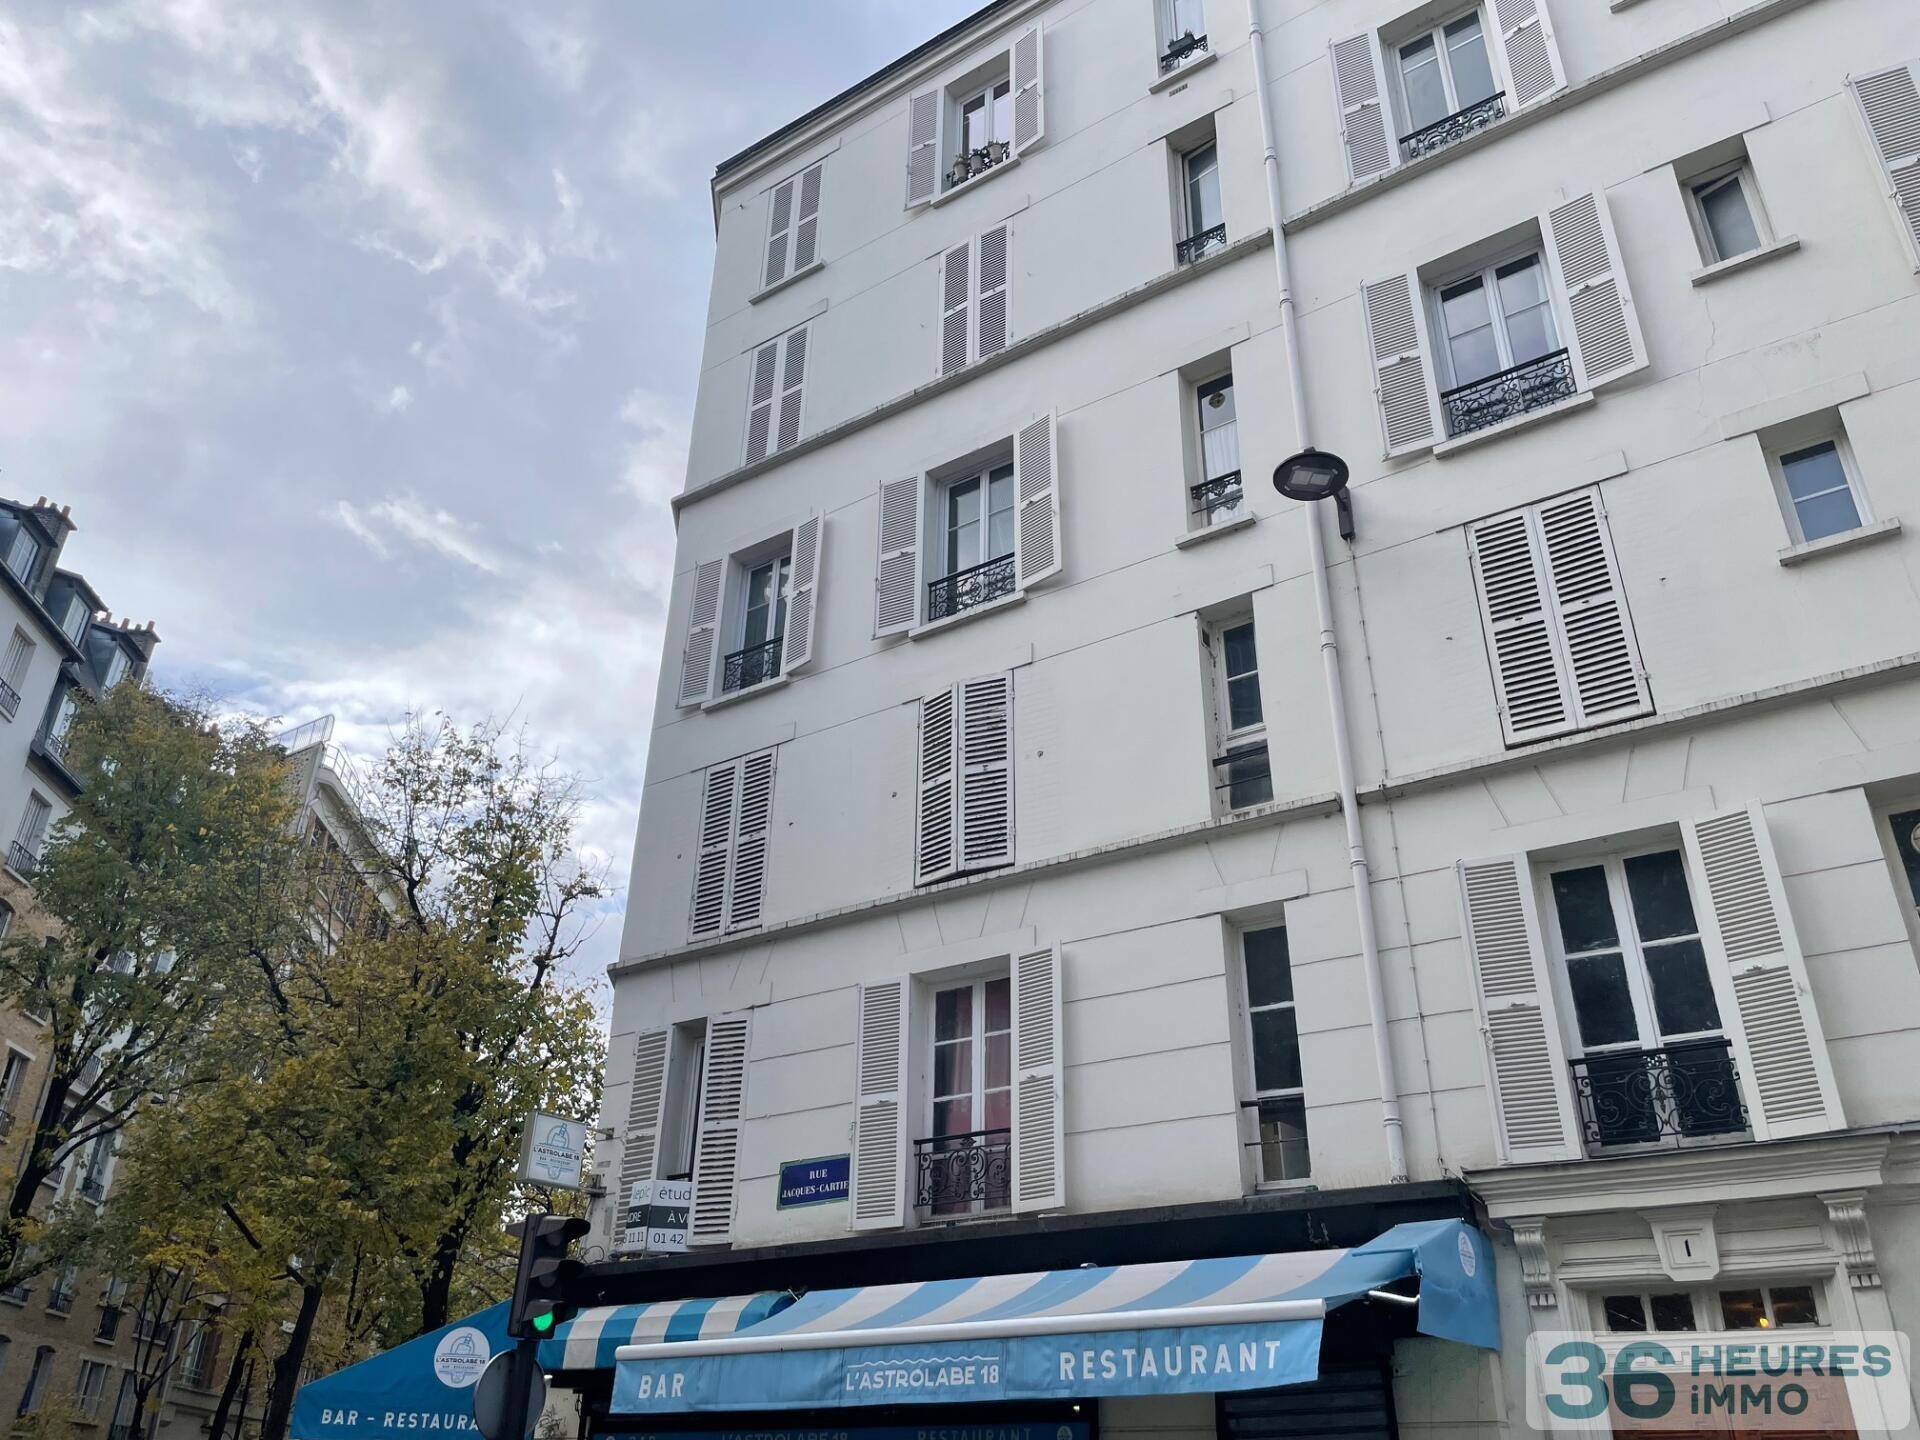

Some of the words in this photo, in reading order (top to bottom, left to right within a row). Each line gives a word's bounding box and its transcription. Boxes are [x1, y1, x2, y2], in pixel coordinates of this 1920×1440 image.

[809, 1168, 828, 1180] RUE
[667, 1209, 676, 1223] À
[678, 1212, 689, 1224] V
[653, 1232, 667, 1244] 01
[670, 1233, 684, 1245] 42
[436, 1357, 478, 1365] L'ASTROLABE
[638, 1373, 685, 1399] BAR
[846, 1365, 976, 1391] L'ASTROLABE
[980, 1364, 1000, 1384] 18
[1060, 1340, 1281, 1381] RESTAURANT
[321, 1408, 359, 1426] BAR
[383, 1411, 479, 1431] RESTAURA
